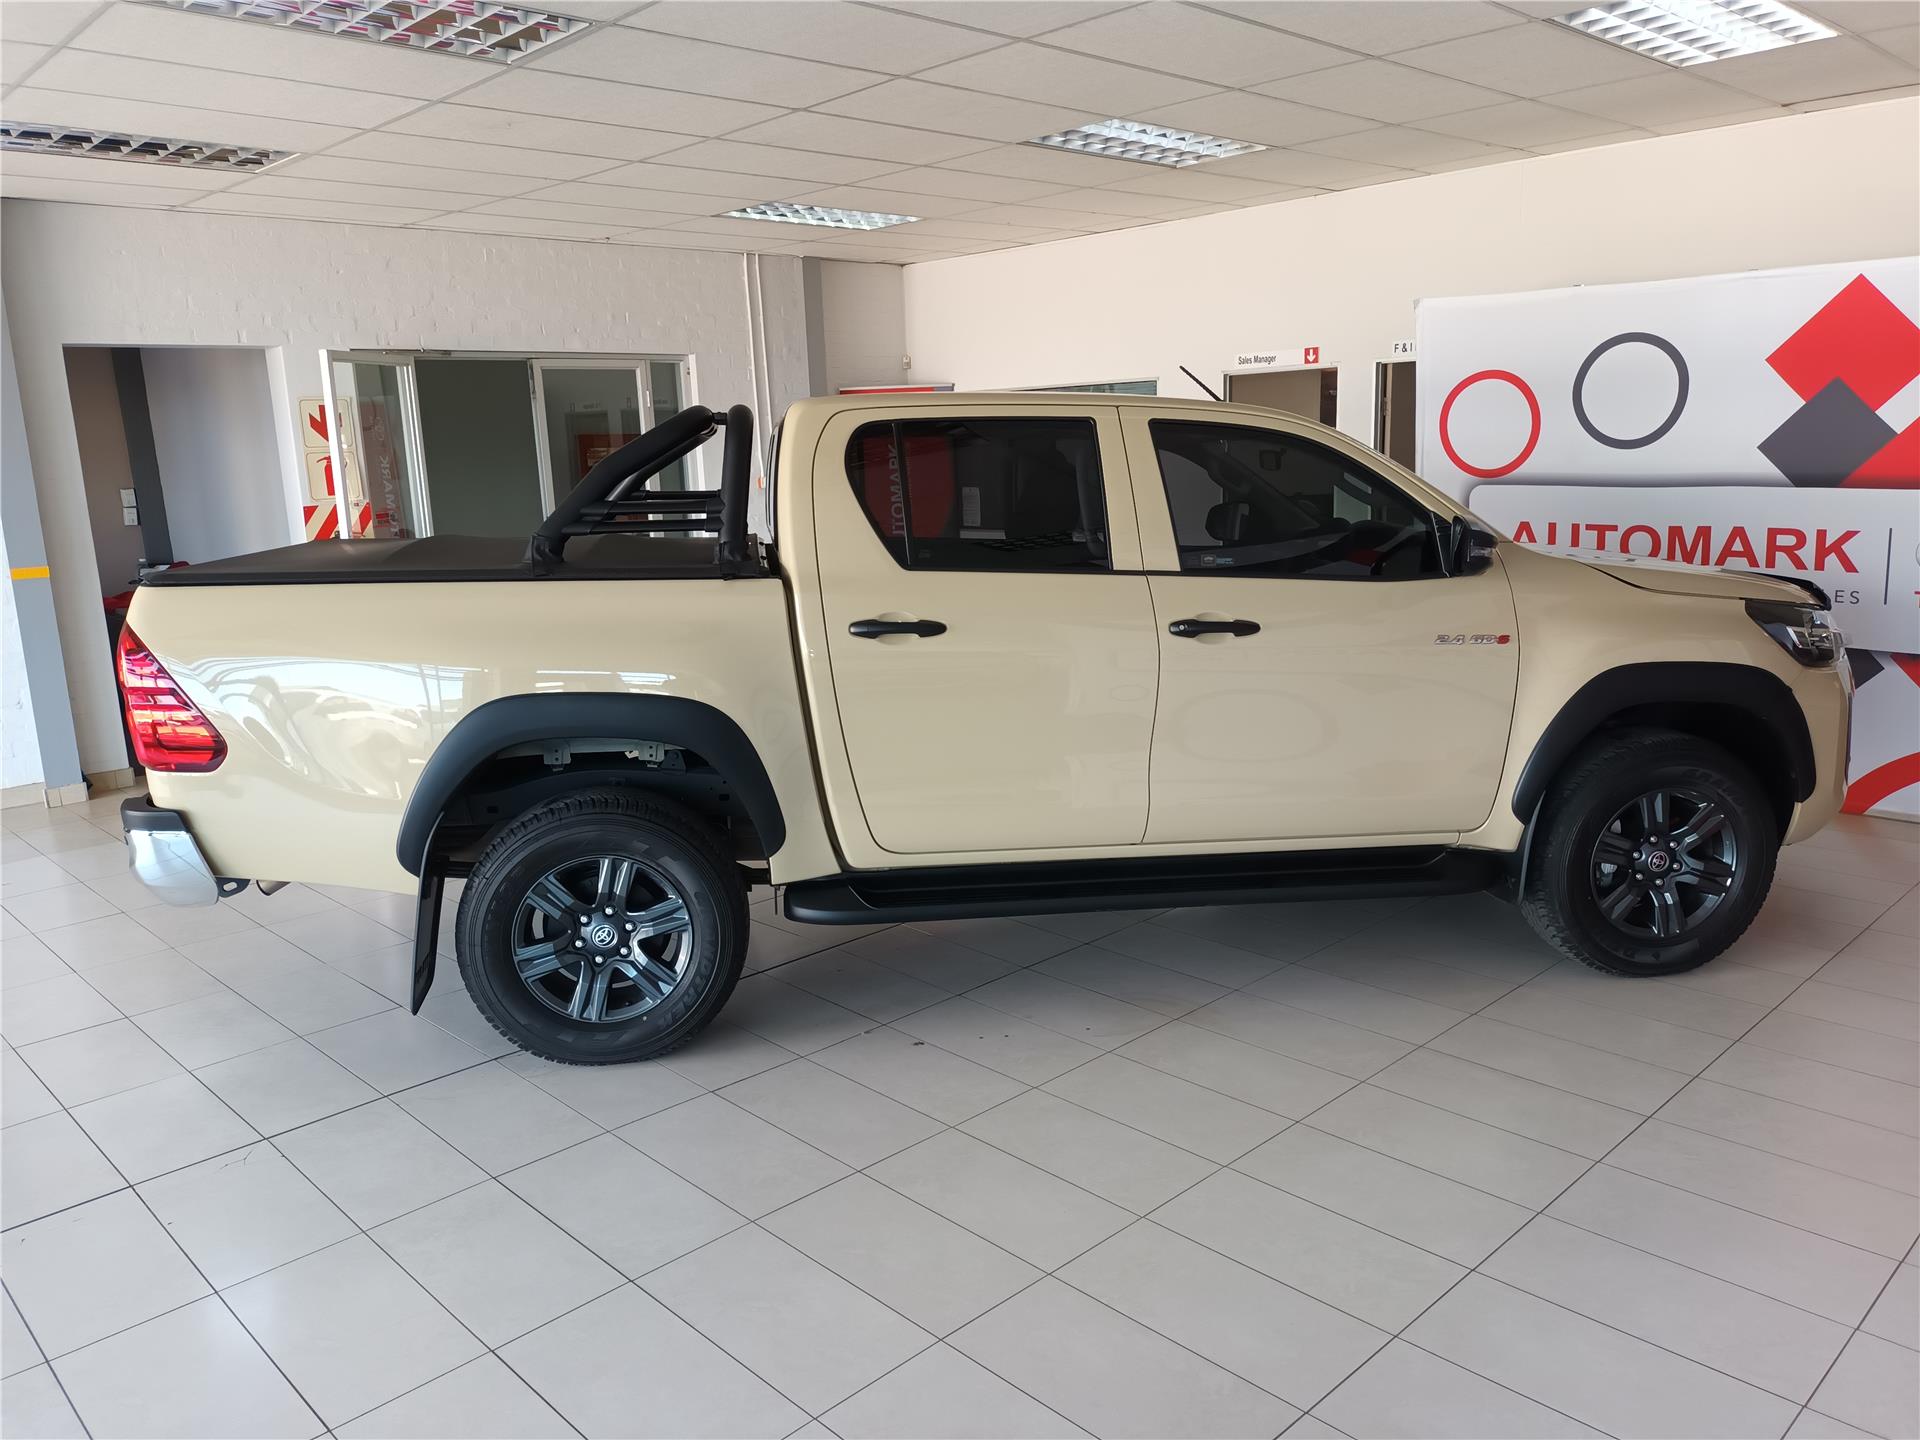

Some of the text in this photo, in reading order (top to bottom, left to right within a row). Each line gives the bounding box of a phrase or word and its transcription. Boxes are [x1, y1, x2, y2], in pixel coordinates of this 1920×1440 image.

[1394, 343, 1399, 354] F
[1401, 342, 1408, 353] &
[1238, 354, 1277, 365] Sales Manager
[1834, 589, 1861, 606] ES
